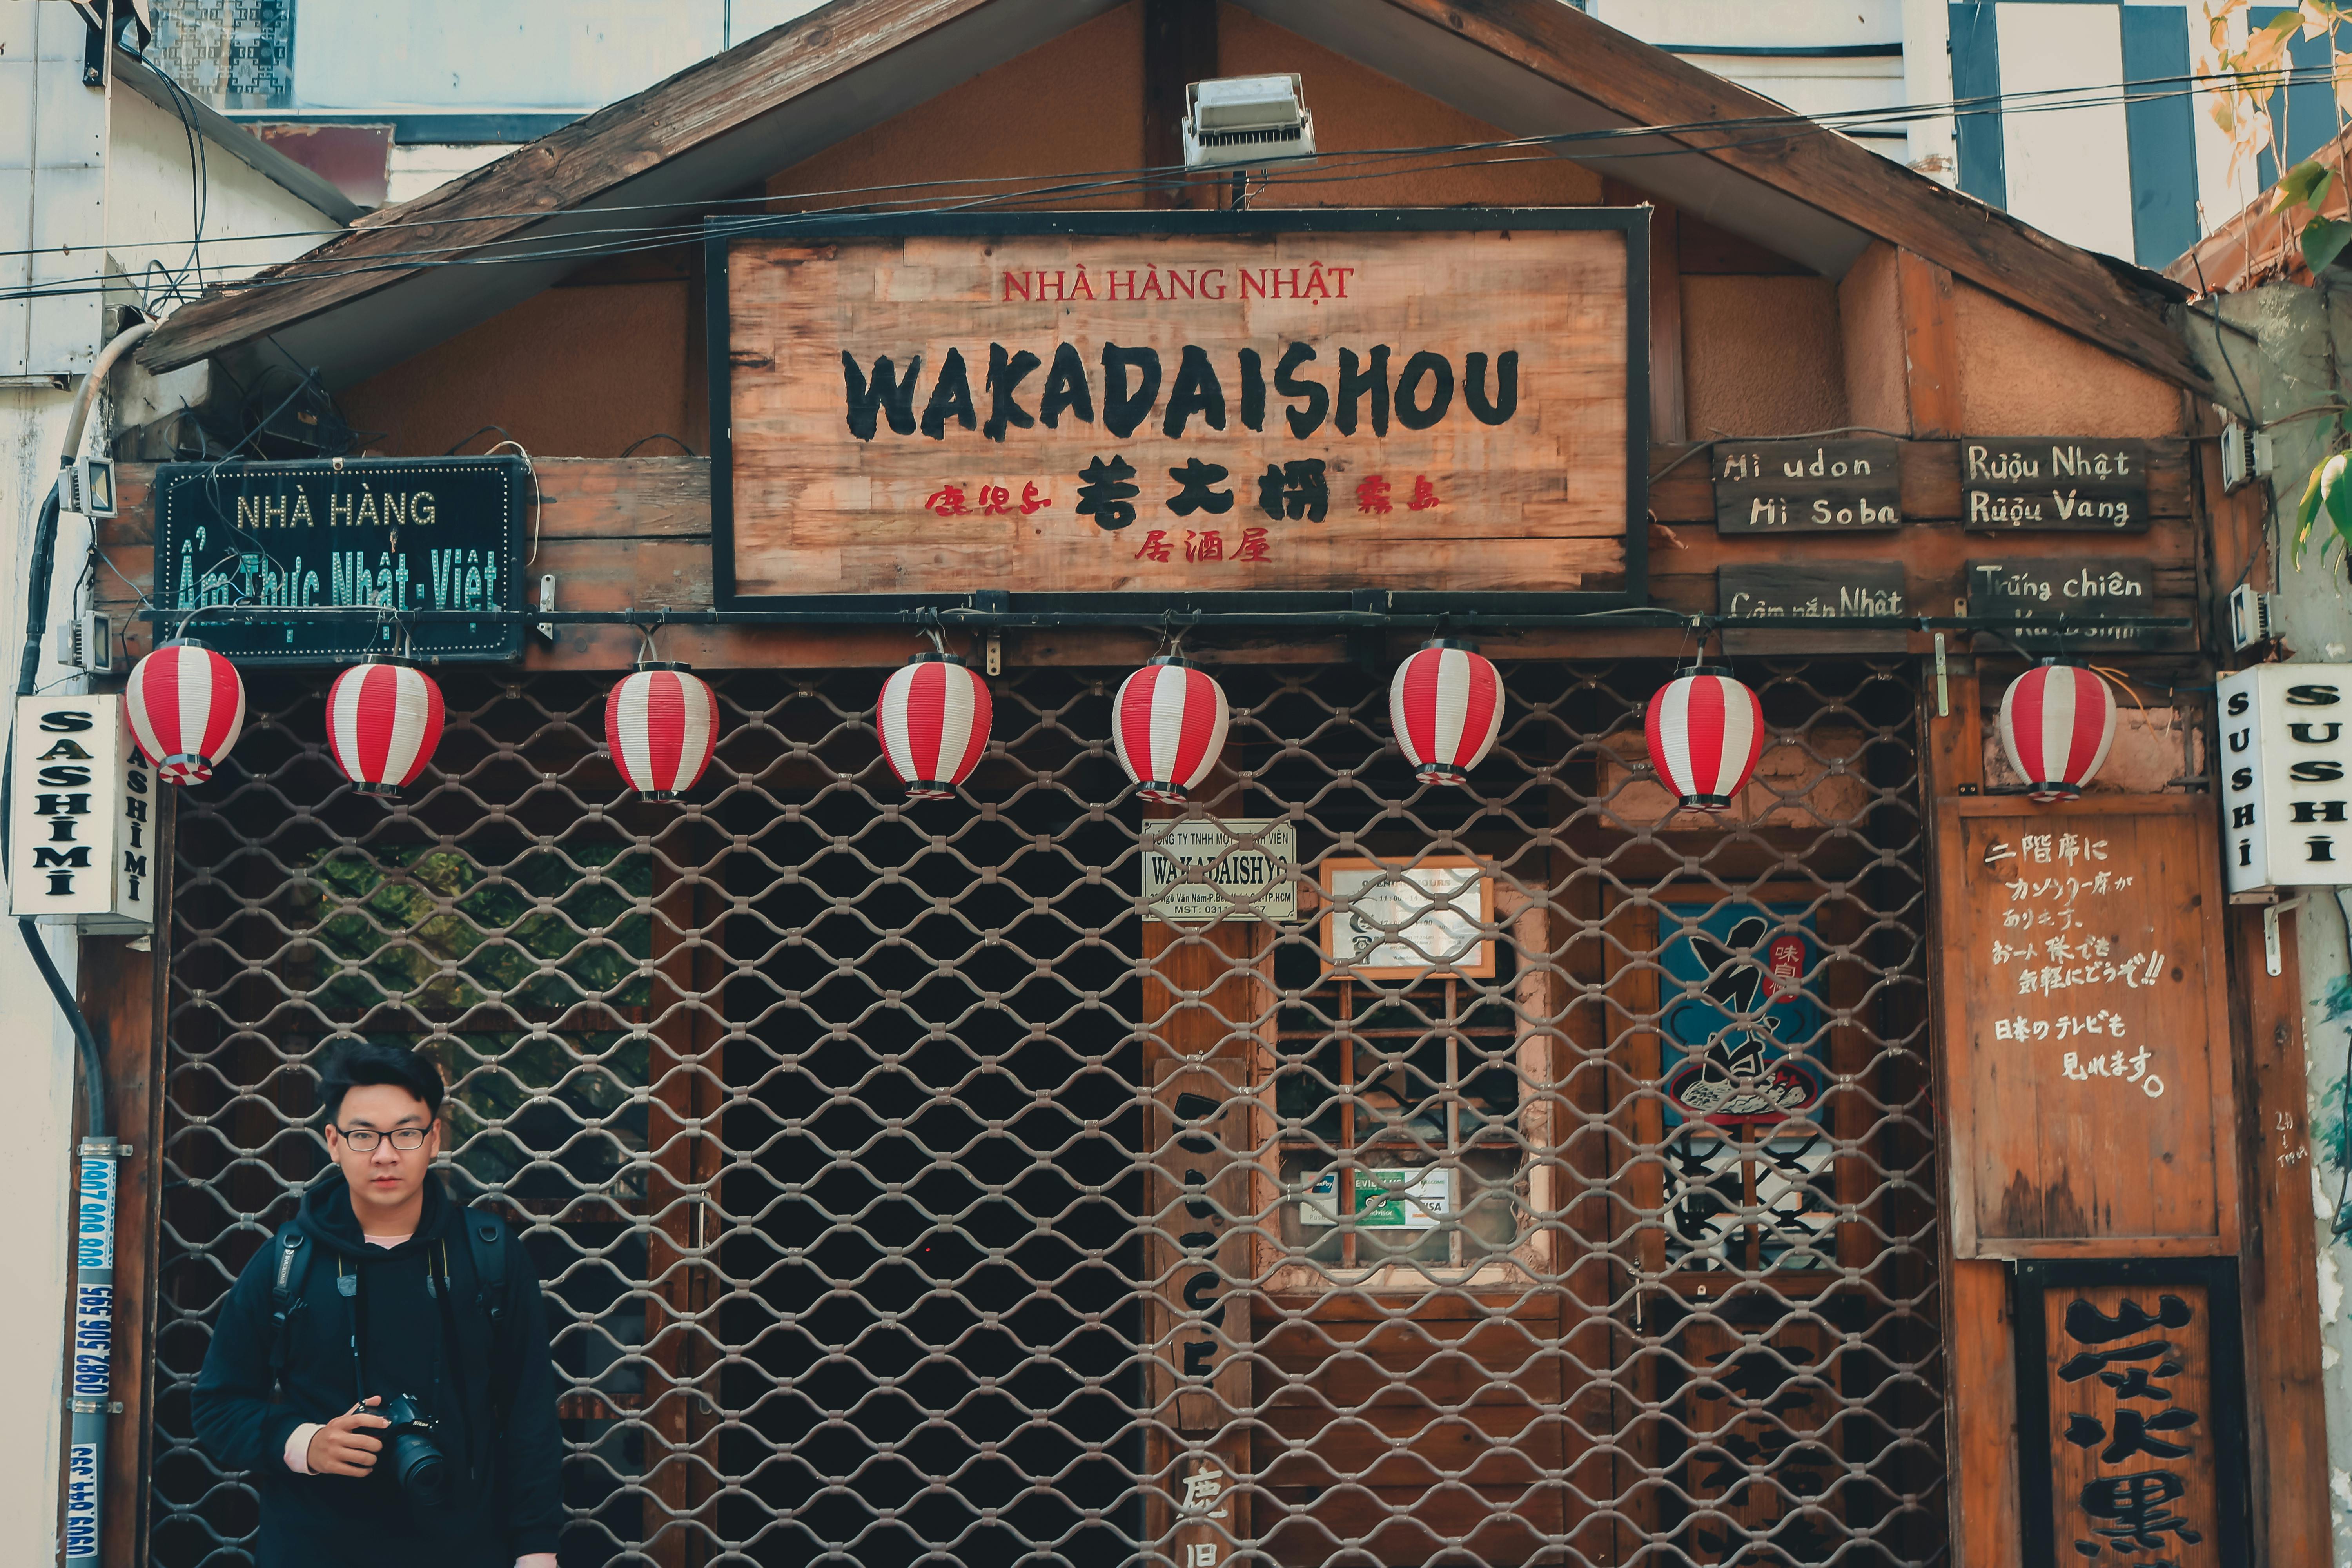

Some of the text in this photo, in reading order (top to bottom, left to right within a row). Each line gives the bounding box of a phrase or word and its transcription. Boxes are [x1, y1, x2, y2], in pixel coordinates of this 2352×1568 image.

[1002, 260, 1354, 306] NHÀ HÀNG NHẬT
[841, 341, 1519, 443] WAKADAISHOU
[1784, 447, 1871, 478] udon
[2052, 445, 2130, 481] Nhật
[237, 483, 436, 528] NHÀ HÀNG
[1811, 497, 1900, 525] Soba
[2052, 489, 2130, 528] Vang
[1134, 527, 1273, 564] 居酒屋
[332, 550, 409, 640] Nhật
[431, 548, 497, 633] Việt
[2063, 567, 2142, 597] chiên
[1177, 833, 1188, 845] TY
[1190, 833, 1214, 845] TNHH
[1269, 829, 1289, 845] VIÊN
[1984, 833, 2109, 867] 二階席に
[1174, 906, 1201, 914] MST:
[1994, 1009, 2127, 1042] 日本のテレビも
[74, 1287, 113, 1394] 0982 506 595
